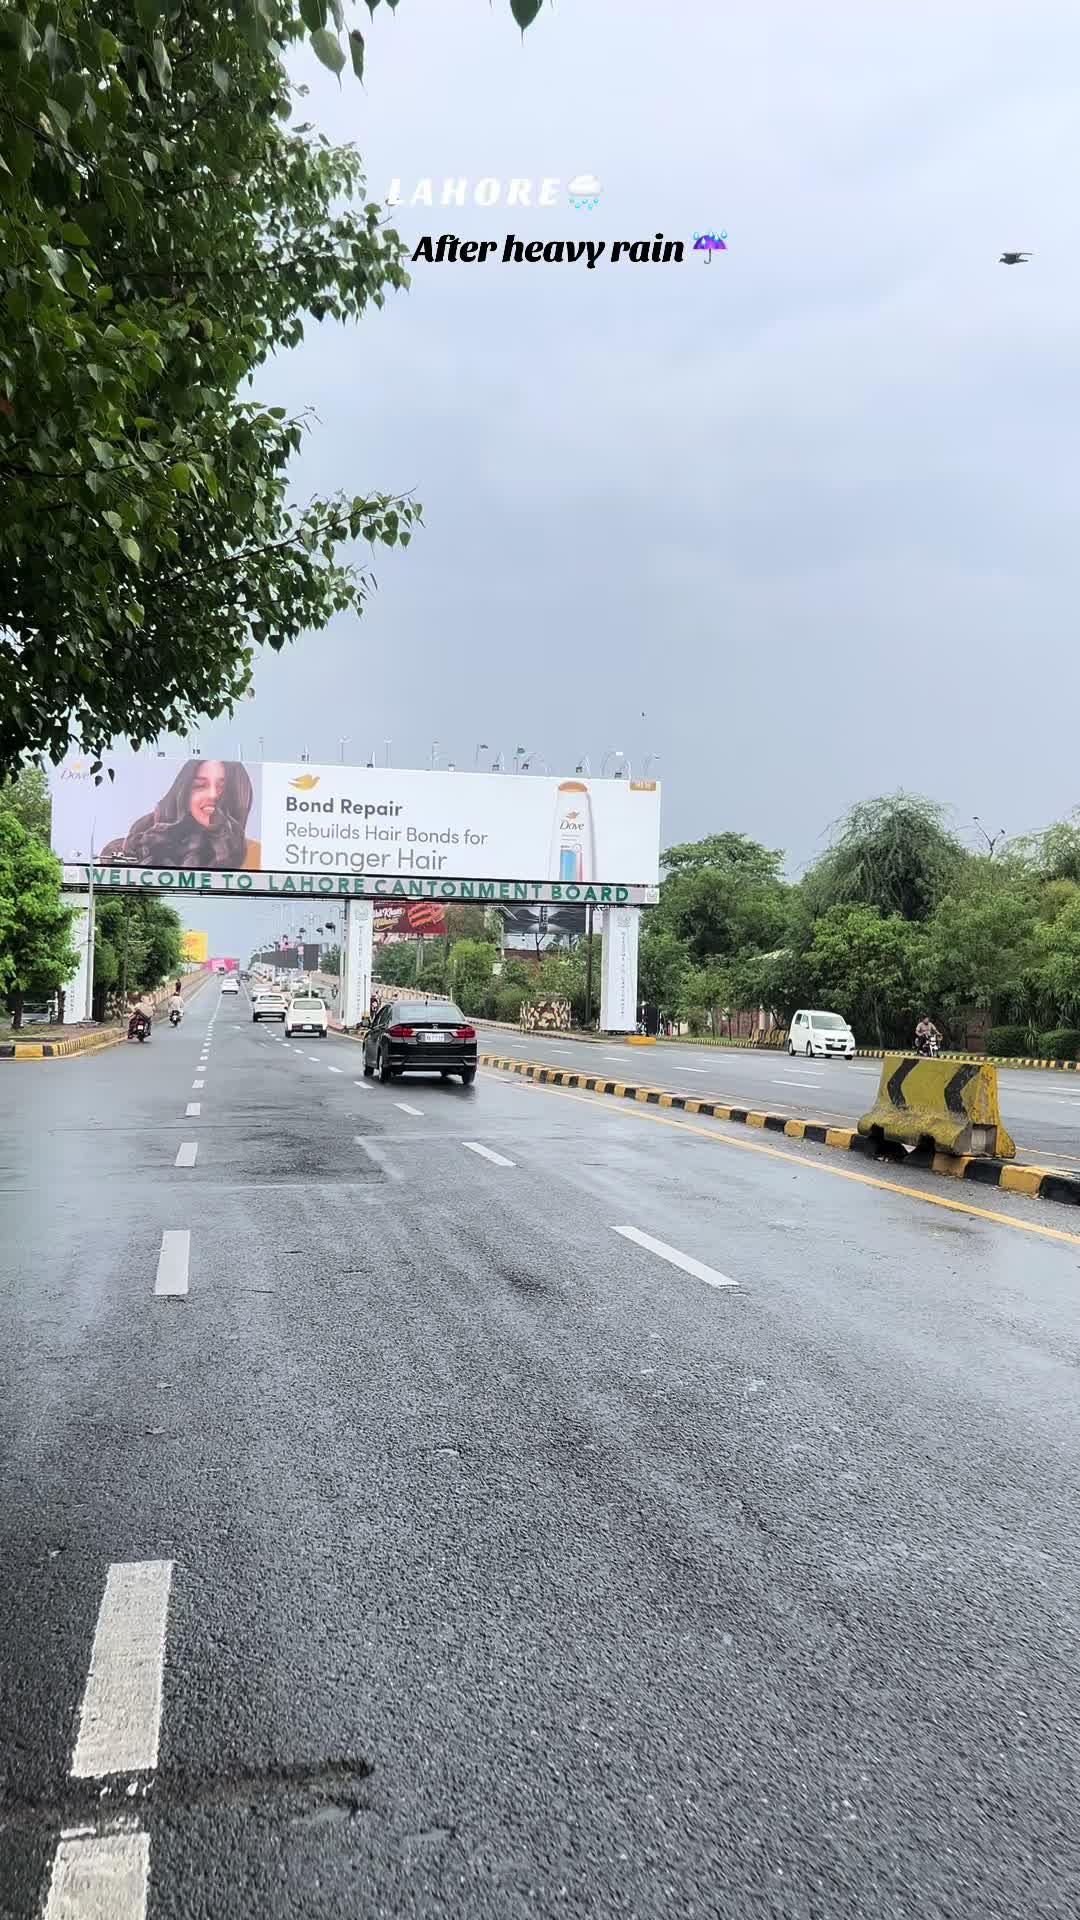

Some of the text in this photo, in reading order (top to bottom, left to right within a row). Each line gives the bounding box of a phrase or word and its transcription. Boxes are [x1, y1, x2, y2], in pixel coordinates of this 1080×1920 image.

[285, 796, 403, 819] Bond Repair
[285, 821, 488, 845] Rebuilds Hair Bonds for
[560, 820, 584, 831] Dove
[285, 844, 447, 873] Stronger Hair
[85, 867, 629, 902] WELCOME TO LAHORE CANTONMENT BOARD
